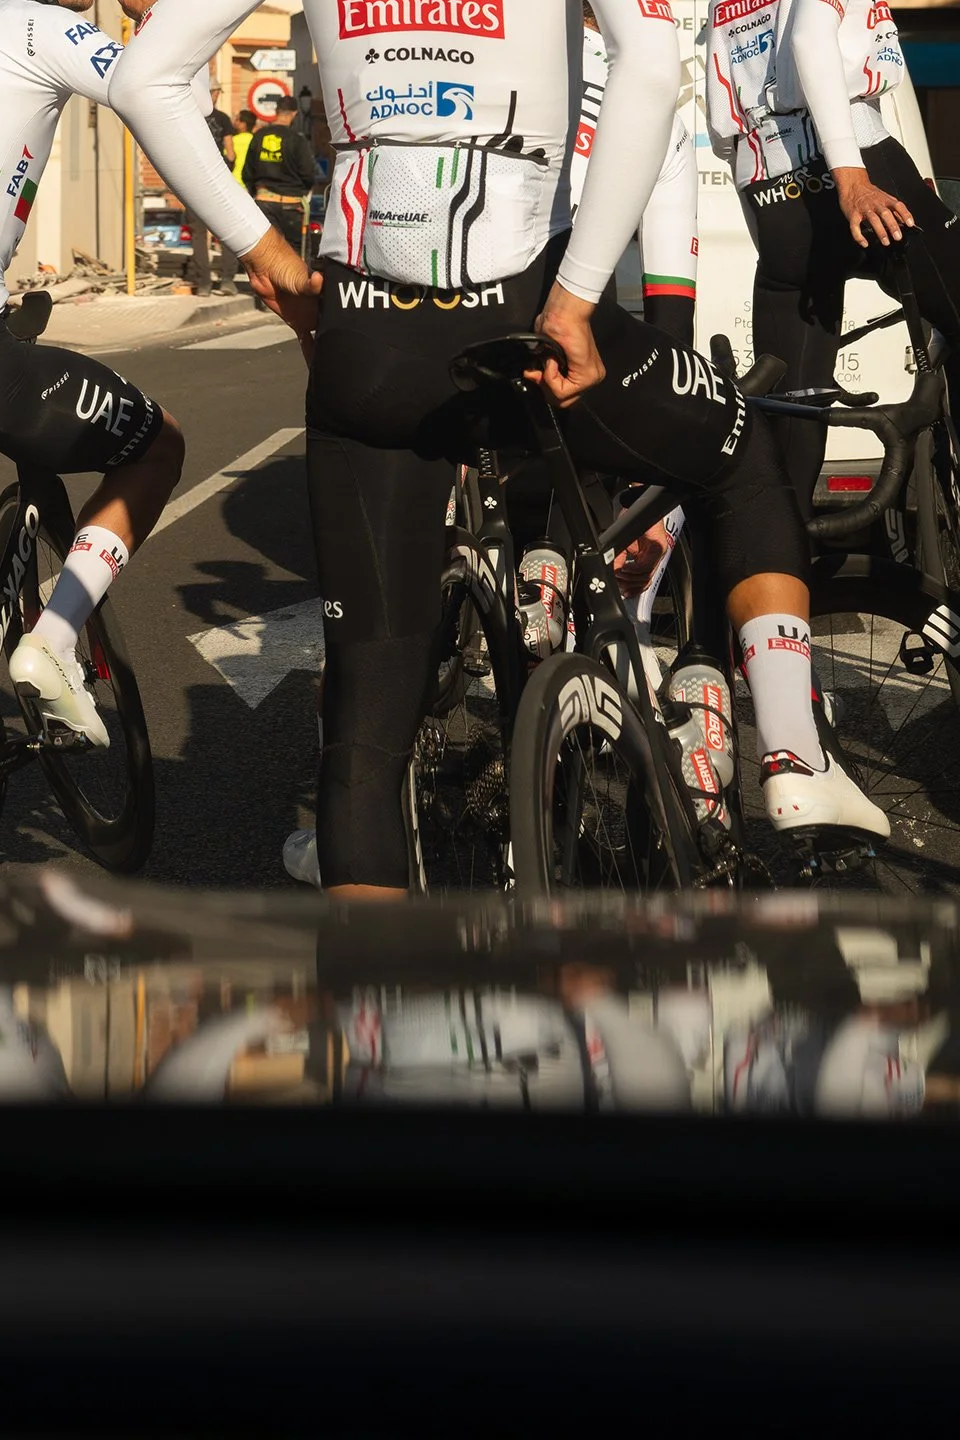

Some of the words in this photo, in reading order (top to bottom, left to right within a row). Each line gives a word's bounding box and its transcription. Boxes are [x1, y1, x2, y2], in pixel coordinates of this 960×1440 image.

[27, 18, 35, 47] PISSEI
[735, 13, 771, 34] COLNAGO
[384, 47, 474, 64] COLNAGO
[732, 47, 760, 65] ADNOC
[370, 103, 433, 120] ADNOC
[6, 159, 29, 197] FAB
[632, 348, 659, 380] PISSEI
[671, 348, 726, 405] UAE
[48, 371, 70, 395] PISSEI
[75, 378, 134, 437] UAE
